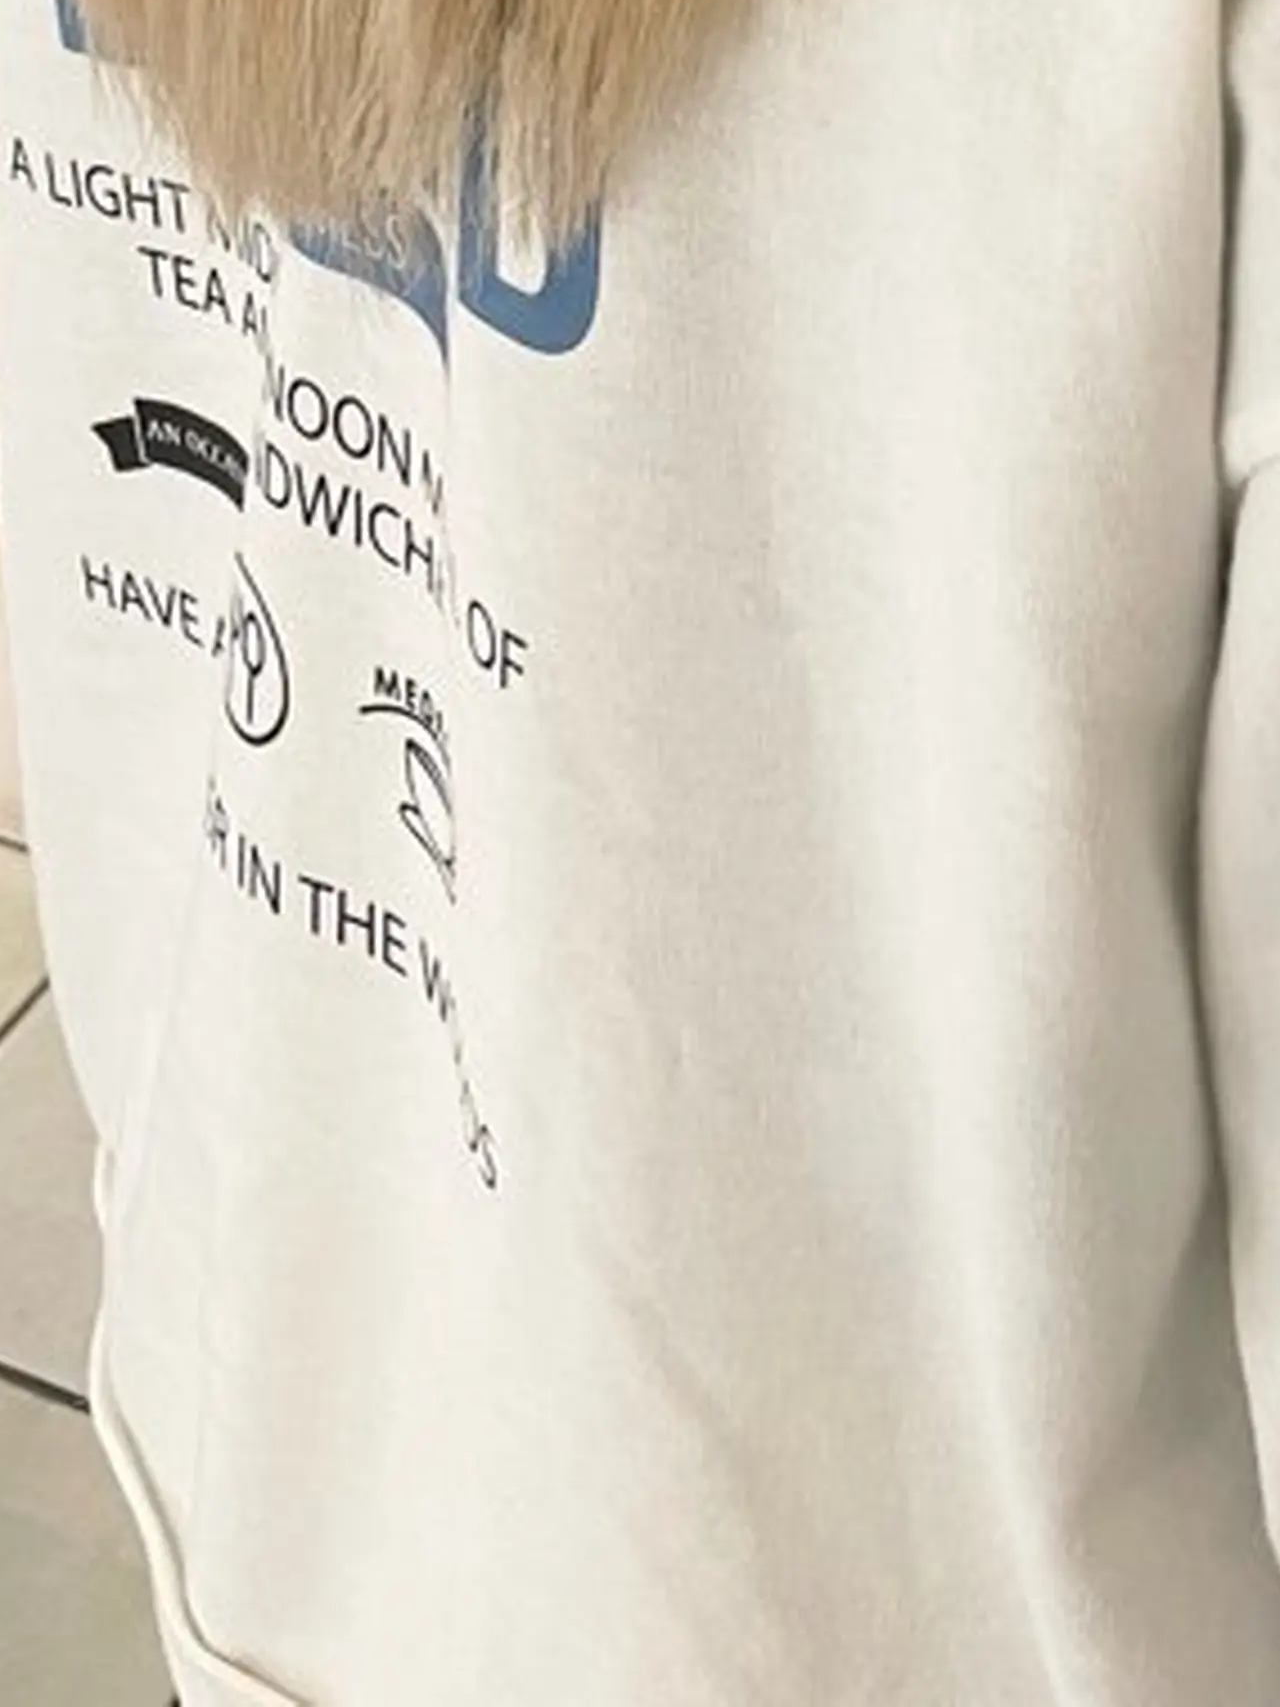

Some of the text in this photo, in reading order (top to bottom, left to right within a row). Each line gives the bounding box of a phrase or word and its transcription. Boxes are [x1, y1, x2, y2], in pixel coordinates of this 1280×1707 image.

[9, 137, 37, 192] A
[45, 151, 189, 234] LIGHT
[138, 244, 233, 326] TEA
[466, 600, 528, 688] OF
[80, 553, 205, 650] HAVE
[236, 833, 281, 916] IN
[297, 872, 410, 978] THE
